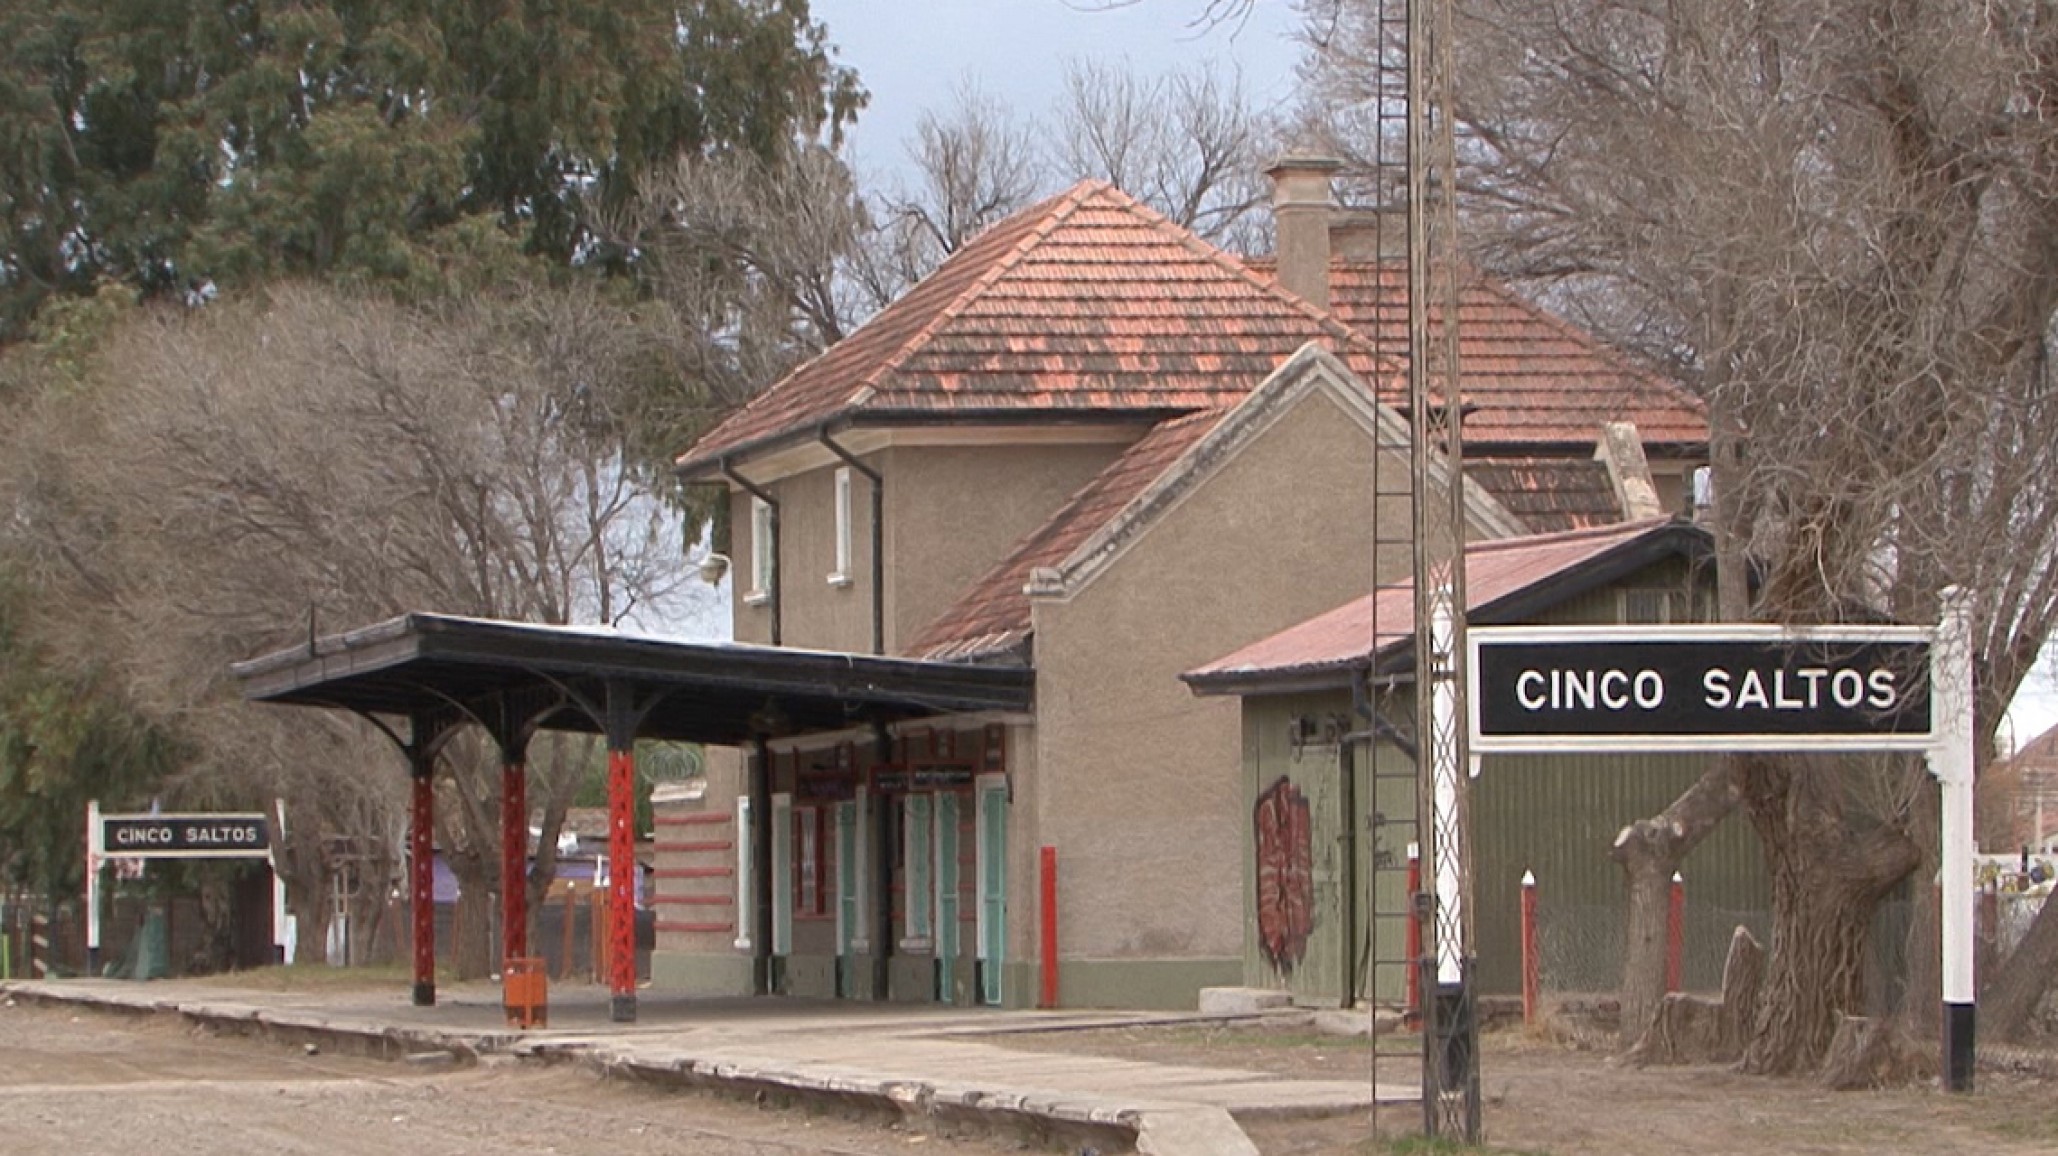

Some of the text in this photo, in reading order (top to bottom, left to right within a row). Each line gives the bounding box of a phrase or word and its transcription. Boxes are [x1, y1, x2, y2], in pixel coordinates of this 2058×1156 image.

[1515, 668, 1897, 709] CINCO SALTOS
[116, 826, 257, 843] CINCO SALTOS
